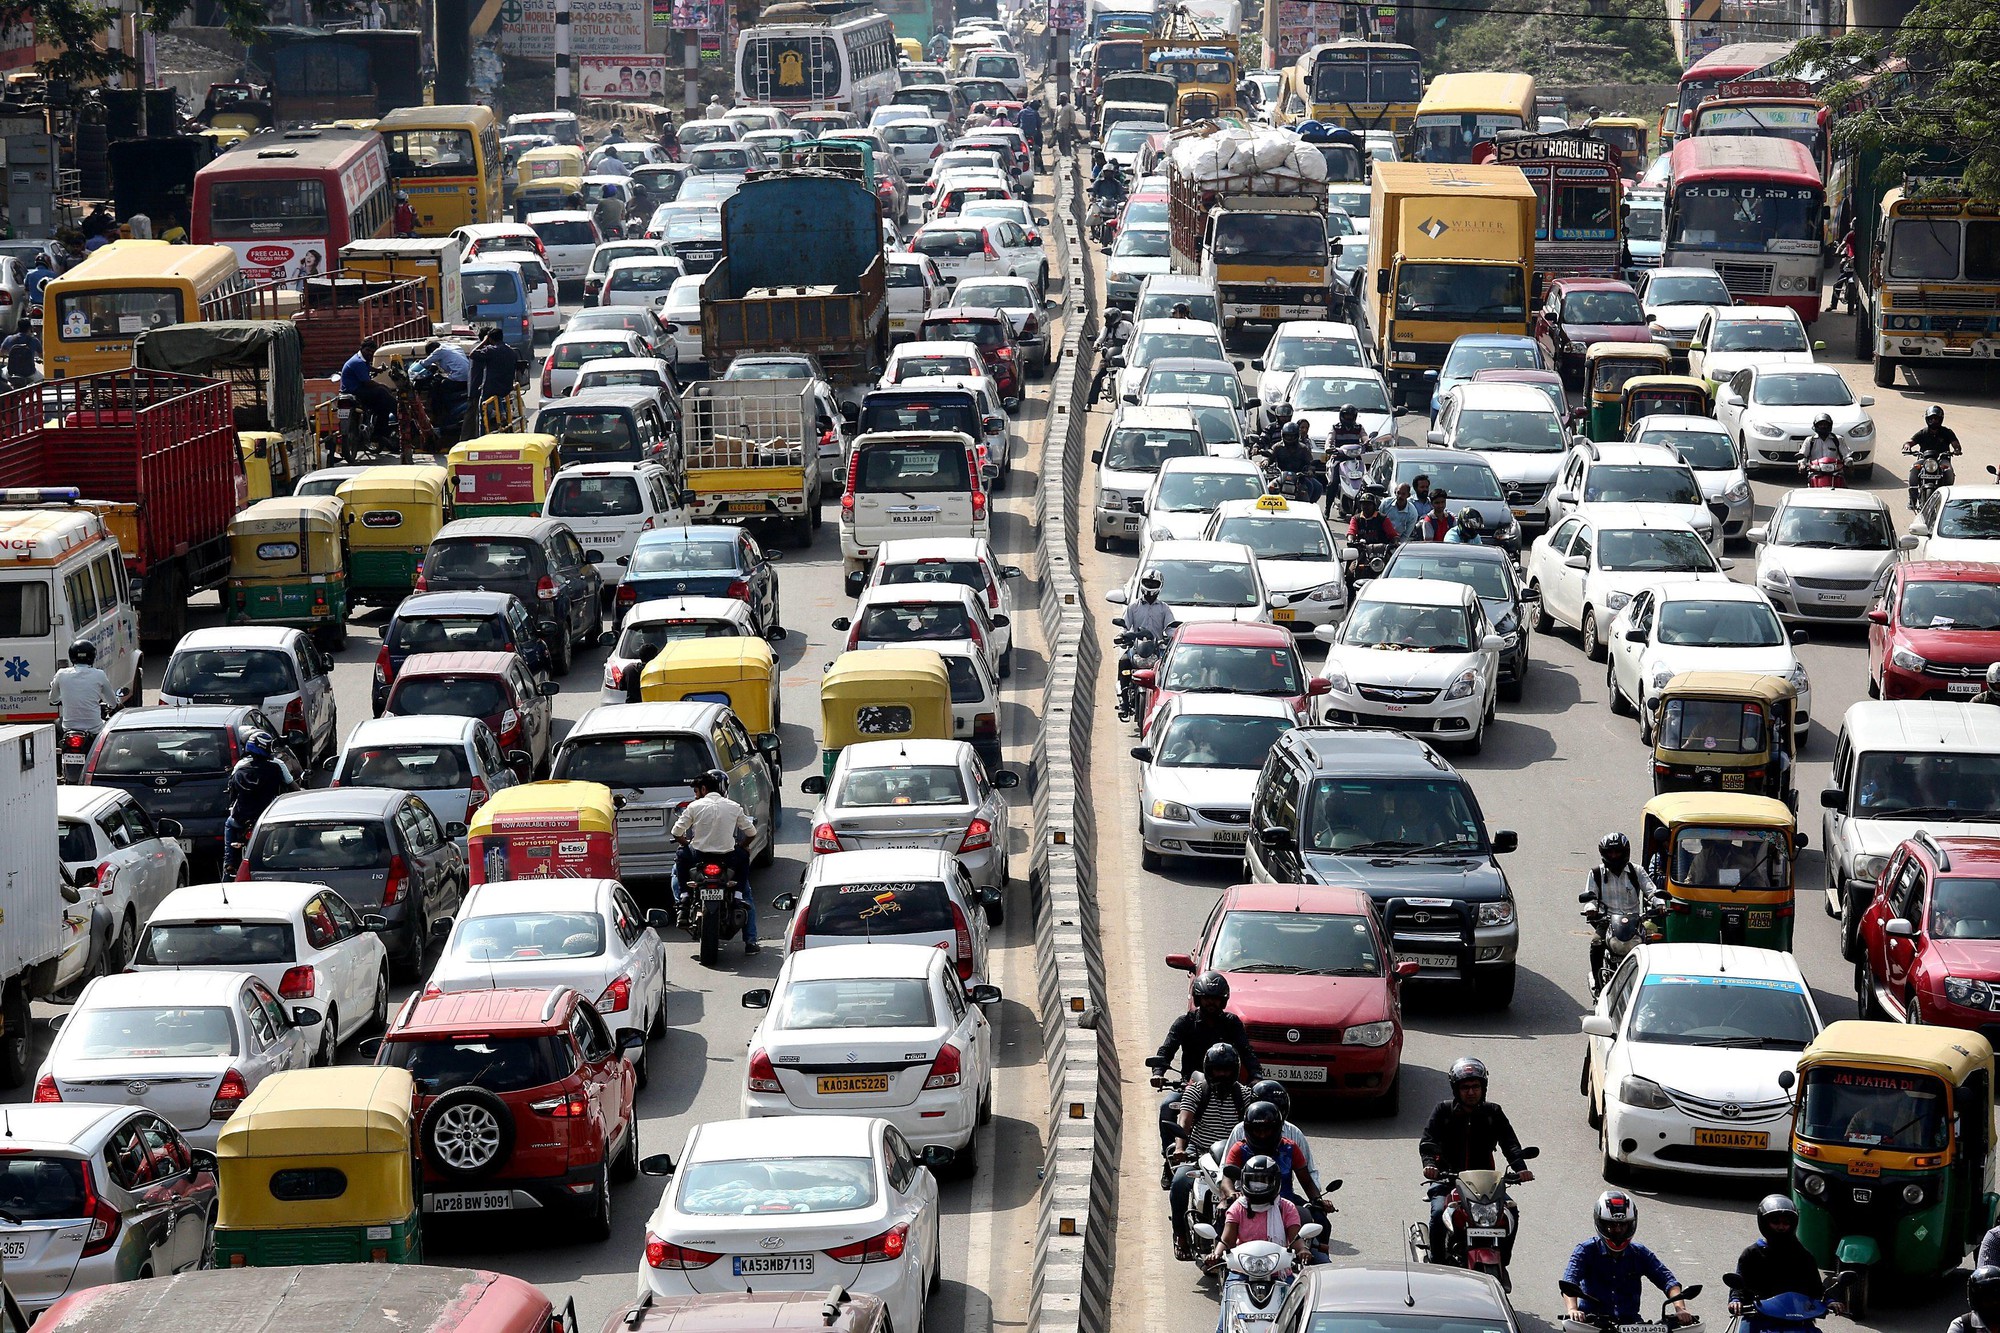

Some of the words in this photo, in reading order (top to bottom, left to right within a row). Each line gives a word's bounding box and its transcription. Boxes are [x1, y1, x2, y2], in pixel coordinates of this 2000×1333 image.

[573, 25, 611, 35] FISTULA
[613, 25, 641, 35] CLINIC
[1500, 142, 1549, 161] SGT
[1451, 220, 1503, 229] WRITER
[10, 695, 38, 704] Bangalore
[1213, 832, 1231, 842] KA03
[562, 845, 585, 853] b-Easy
[839, 883, 916, 895] SHARANU
[1278, 1069, 1288, 1078] 53
[1289, 1070, 1302, 1079] MA
[1303, 1070, 1323, 1080] 3259
[823, 1078, 886, 1091] KA03AC5226
[1833, 1073, 1852, 1085] JAI
[1855, 1075, 1897, 1089] MATHA
[1900, 1080, 1913, 1090] DI
[1701, 1133, 1766, 1146] KA03AA6714
[436, 1198, 463, 1211] AP28
[465, 1197, 482, 1210] BW
[484, 1195, 509, 1209] 9091
[3, 1242, 25, 1255] 3675
[741, 1258, 813, 1272] KA53MB7113
